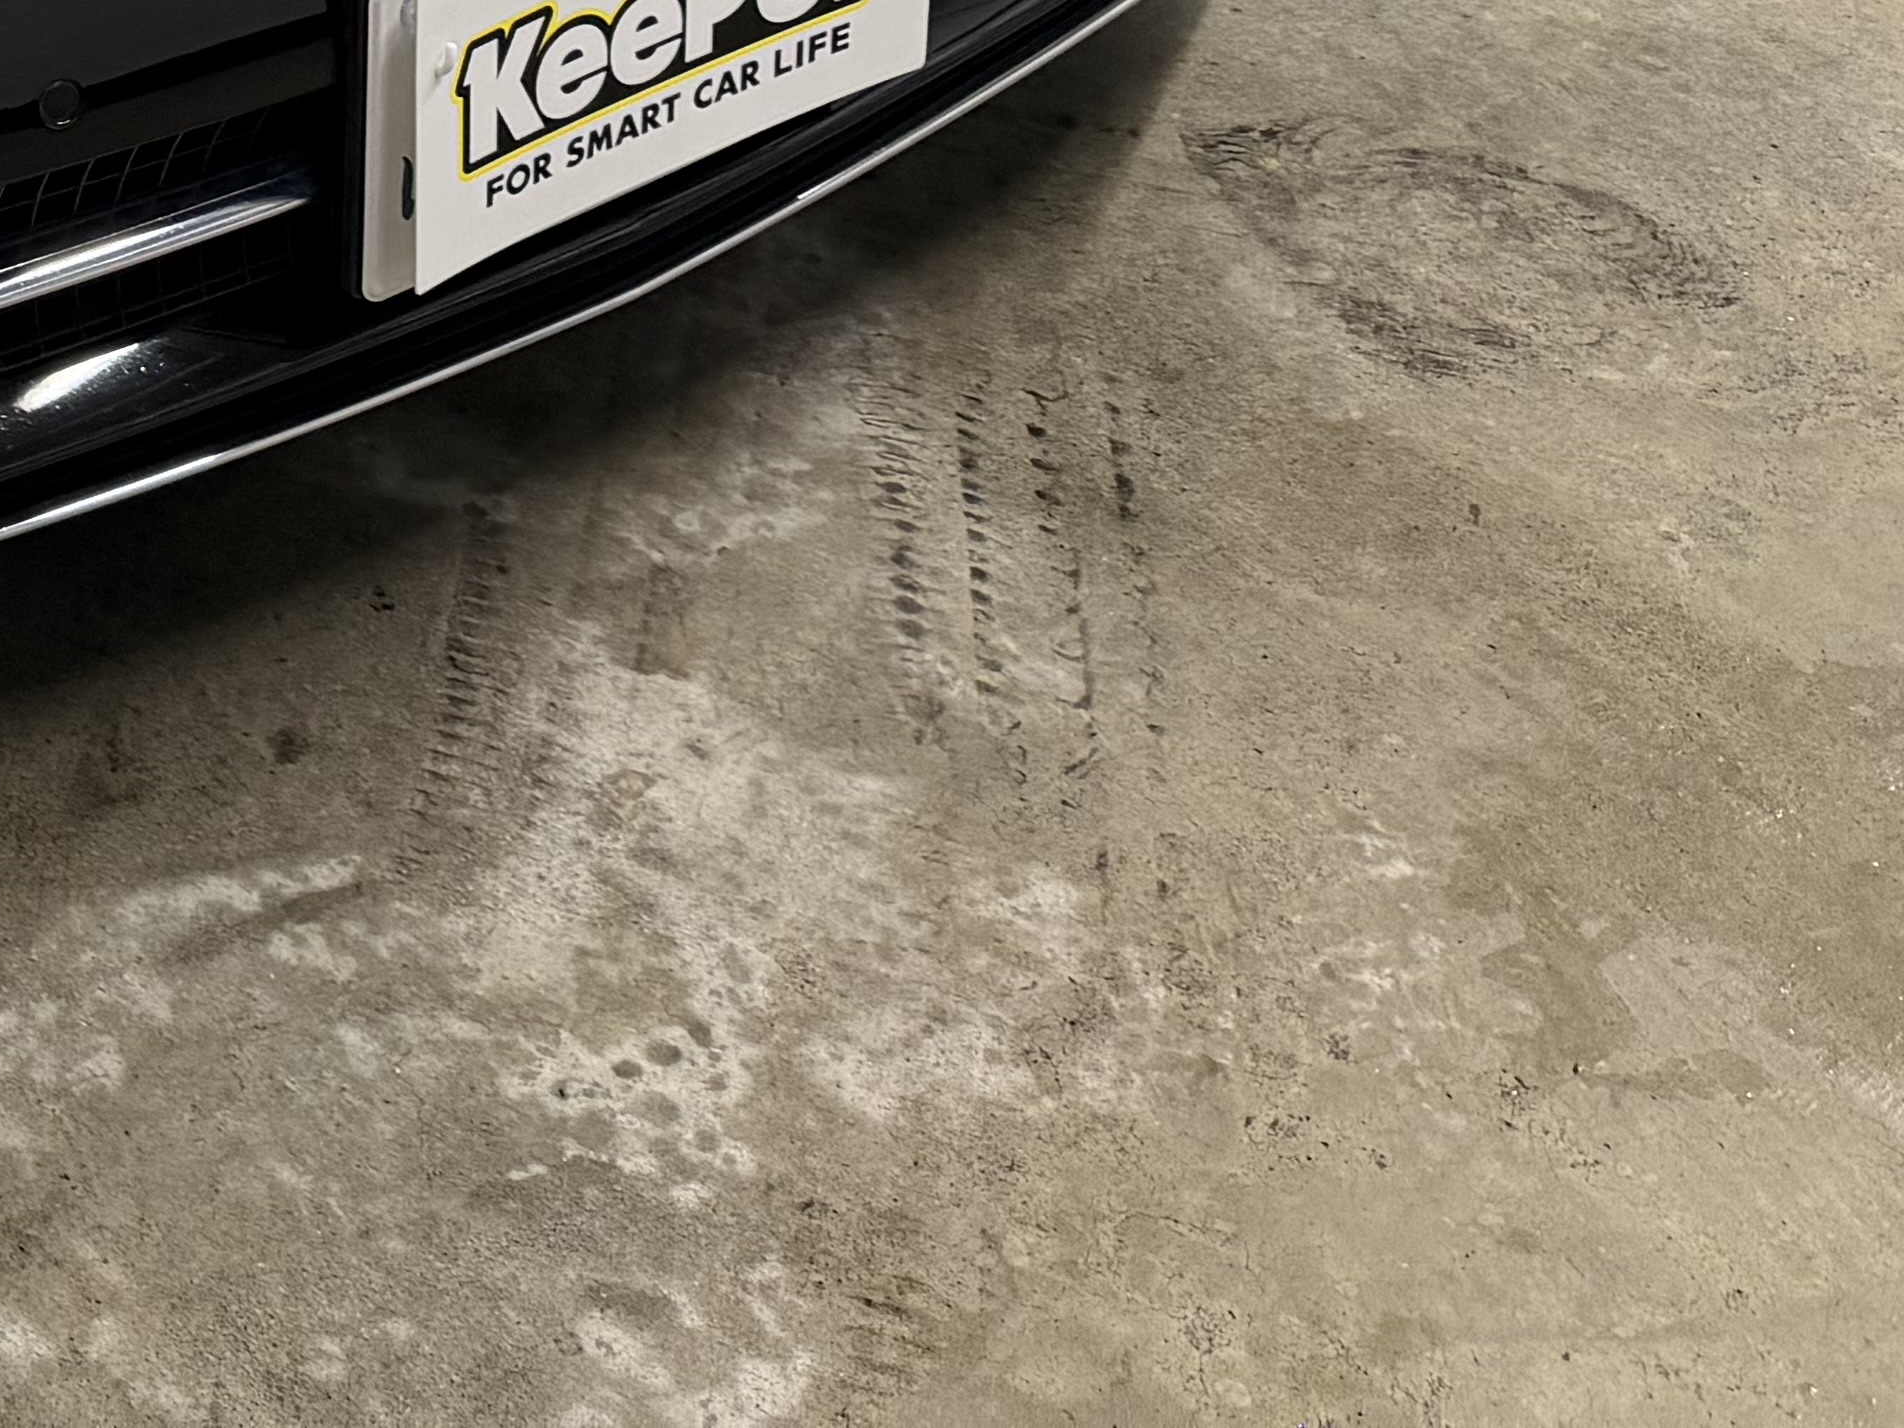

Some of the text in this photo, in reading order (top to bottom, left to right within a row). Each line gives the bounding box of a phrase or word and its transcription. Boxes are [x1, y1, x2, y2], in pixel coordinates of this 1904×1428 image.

[486, 21, 852, 208] FOR SMART CAR LIFE
